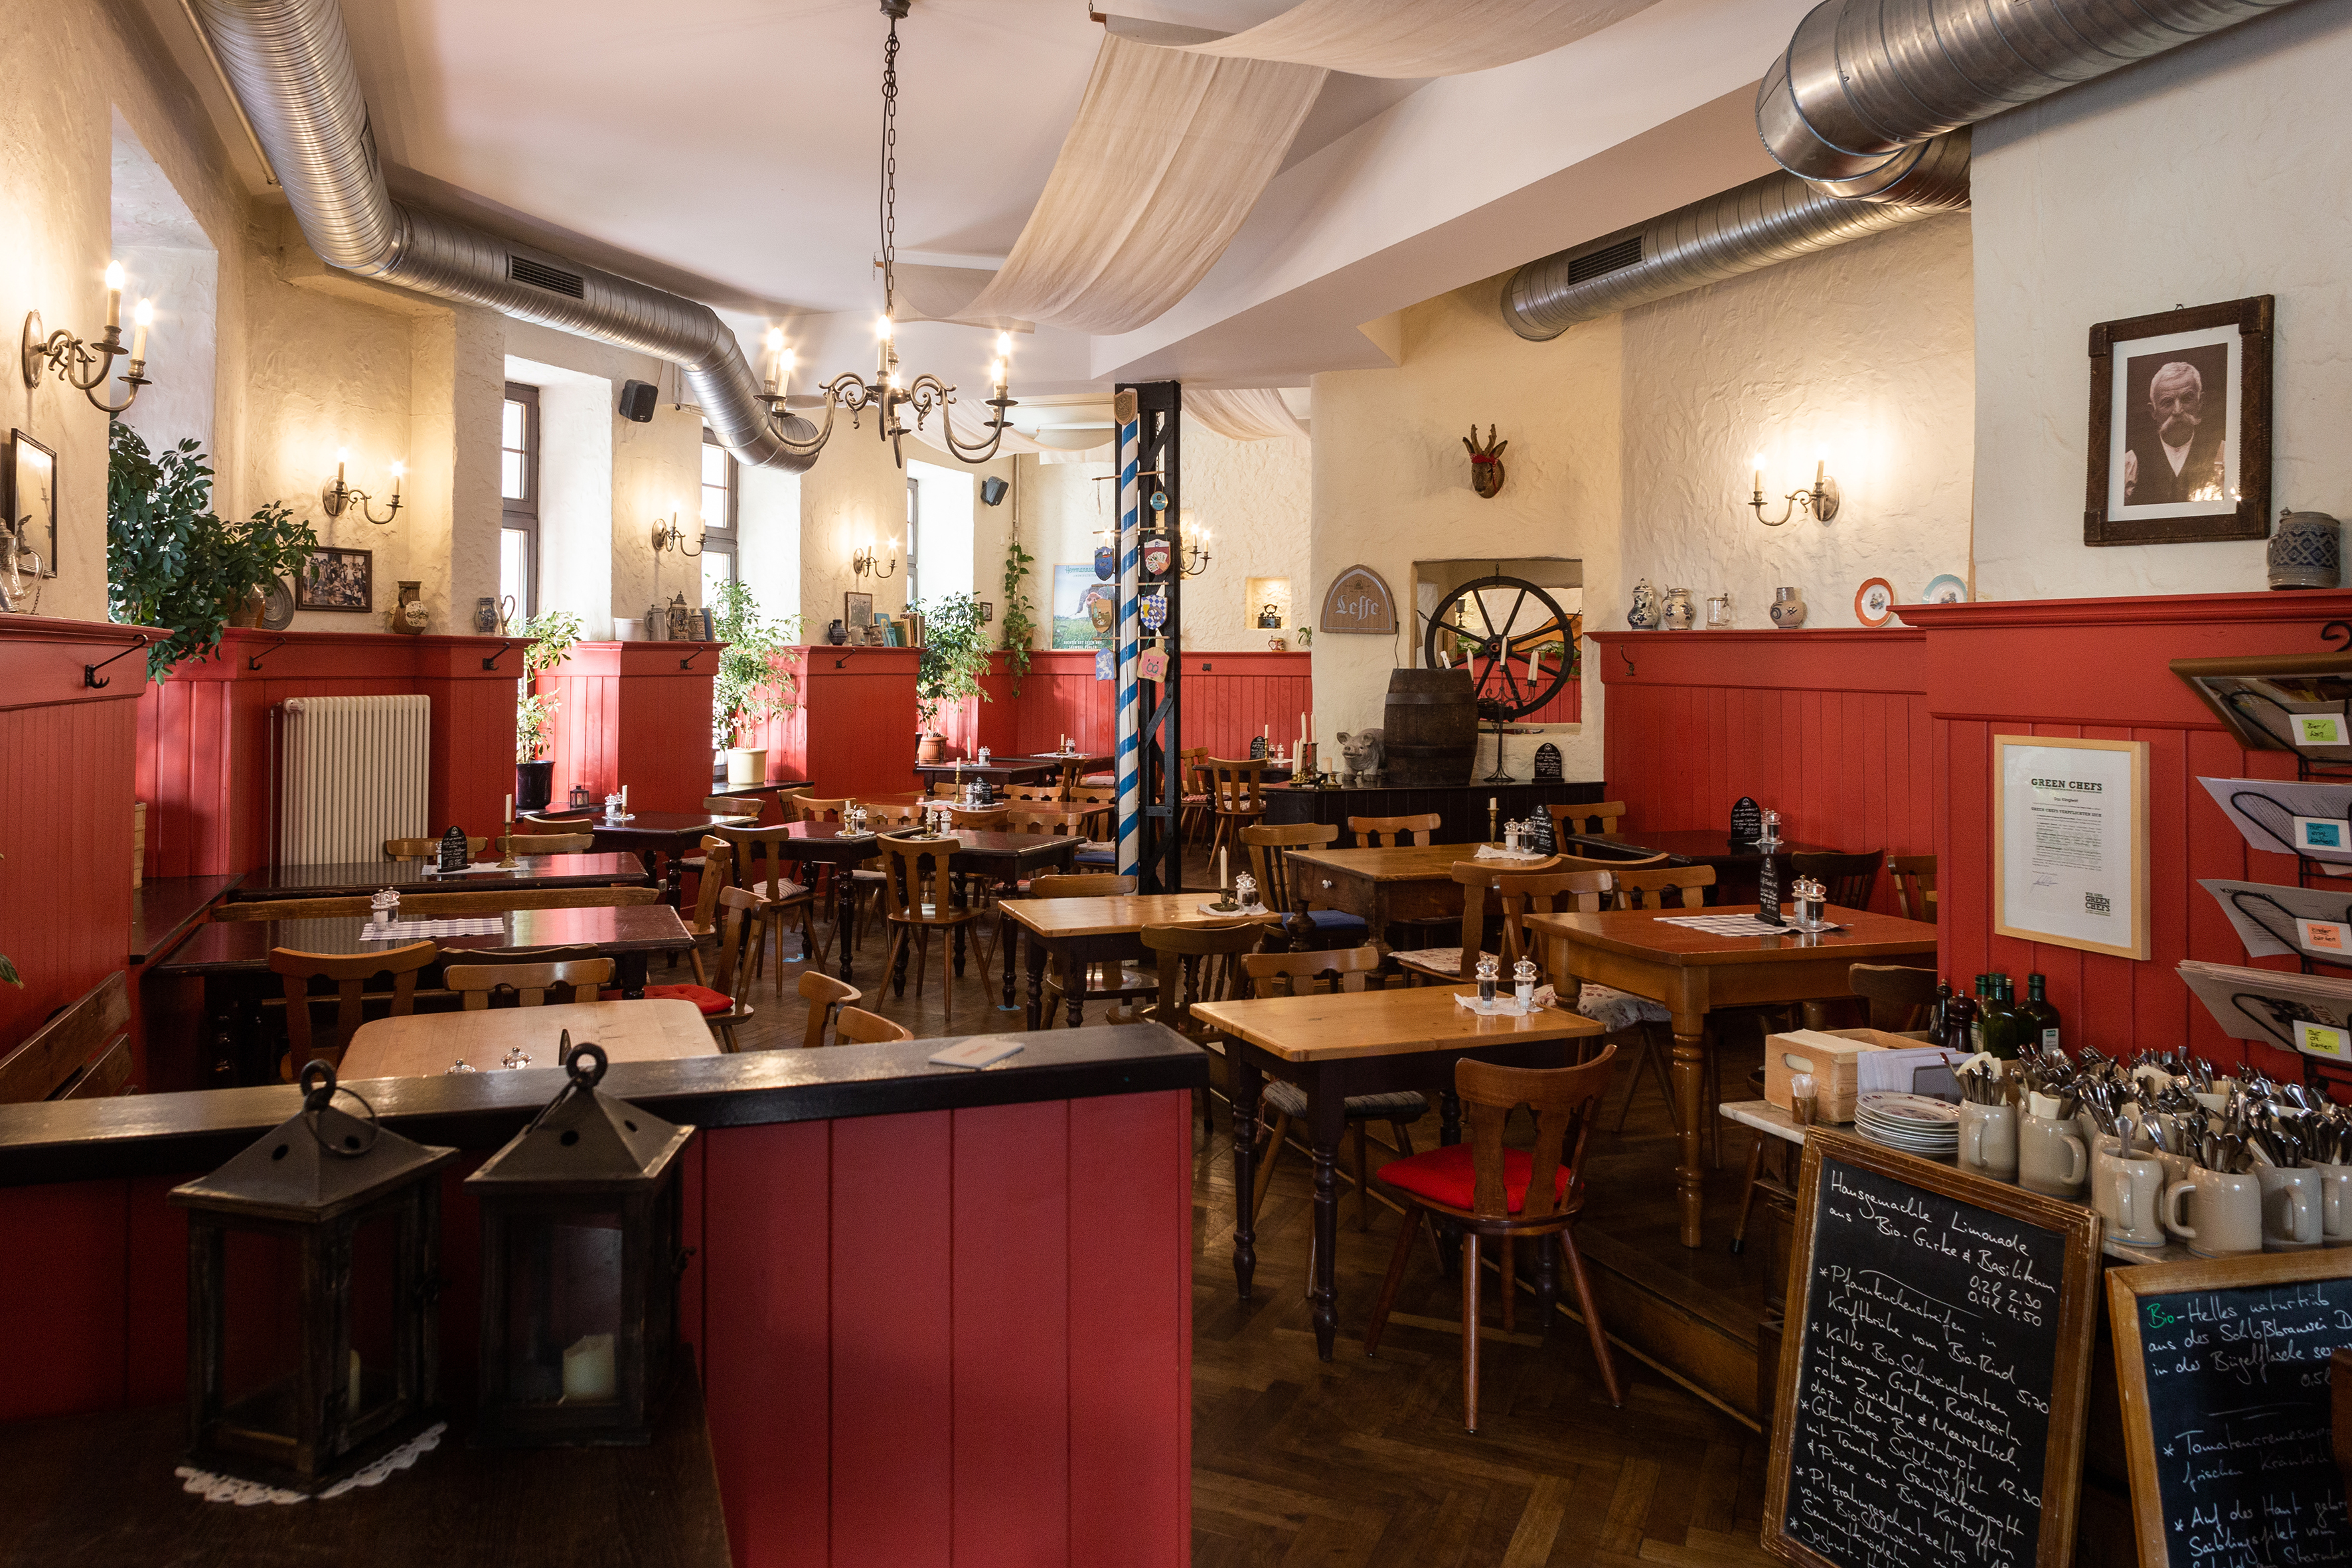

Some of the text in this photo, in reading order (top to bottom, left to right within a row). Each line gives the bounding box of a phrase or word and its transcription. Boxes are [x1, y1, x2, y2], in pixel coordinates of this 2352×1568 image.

[1334, 594, 1379, 621] Leffe
[2031, 778, 2065, 788] GREEN
[2069, 781, 2102, 791] CHEFS
[2085, 896, 2110, 905] GREEN
[2085, 902, 2110, 912] CHEFS
[1829, 1207, 1852, 1222] aus
[1978, 1249, 2057, 1293] Basilikum
[1951, 1211, 2030, 1257] Limonade
[1831, 1264, 1996, 1347] Pfannkuchenstreifen in
[2250, 1283, 2330, 1315] naturtrüb
[1828, 1291, 1903, 1338] Kraftbrühe
[1912, 1333, 1938, 1352] vom
[1816, 1345, 1837, 1362] mit
[1841, 1356, 1881, 1380] sauren
[2148, 1340, 2177, 1353] aus
[2153, 1363, 2168, 1377] in
[2210, 1340, 2306, 1385] Bügelflasche
[1810, 1378, 1843, 1405] dazu
[1814, 1362, 1848, 1386] roten
[1855, 1377, 1914, 1420] Zwiebeln
[1807, 1423, 1828, 1438] mit
[1812, 1395, 1880, 1442] Gebratenes
[2182, 1458, 2244, 1493] frischen
[1800, 1486, 1825, 1504] vom
[1818, 1444, 1859, 1475] Püree
[1865, 1472, 1887, 1489] aus
[1933, 1500, 2015, 1561] Kartoffeln
[2191, 1501, 2224, 1537] Auf
[2306, 1528, 2335, 1538] vom
